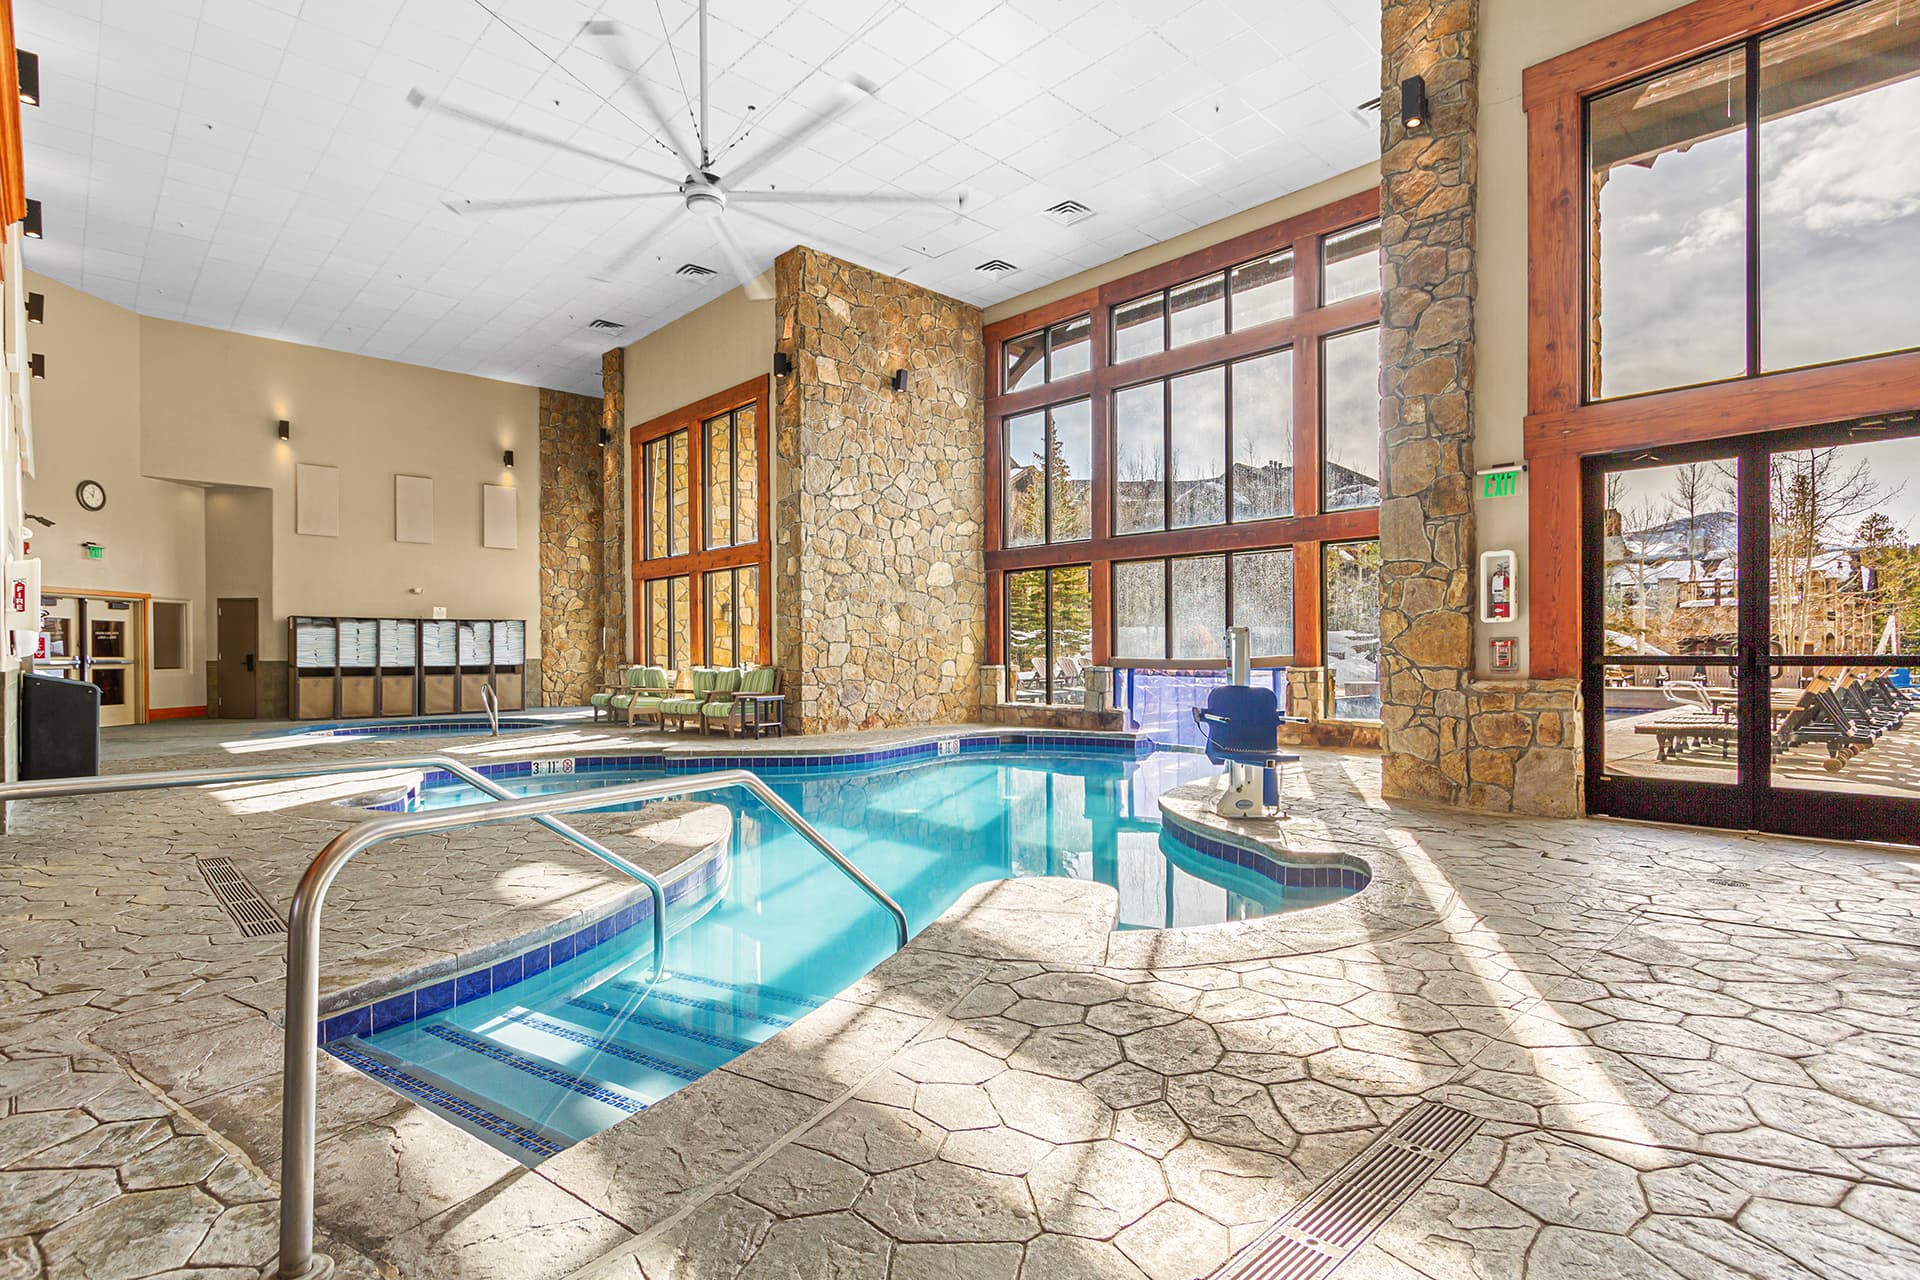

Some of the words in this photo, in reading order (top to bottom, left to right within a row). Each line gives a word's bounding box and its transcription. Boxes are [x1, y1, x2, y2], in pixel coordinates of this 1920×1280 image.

[1483, 471, 1519, 497] EXIT
[15, 585, 25, 612] FIRE
[532, 762, 540, 775] 3
